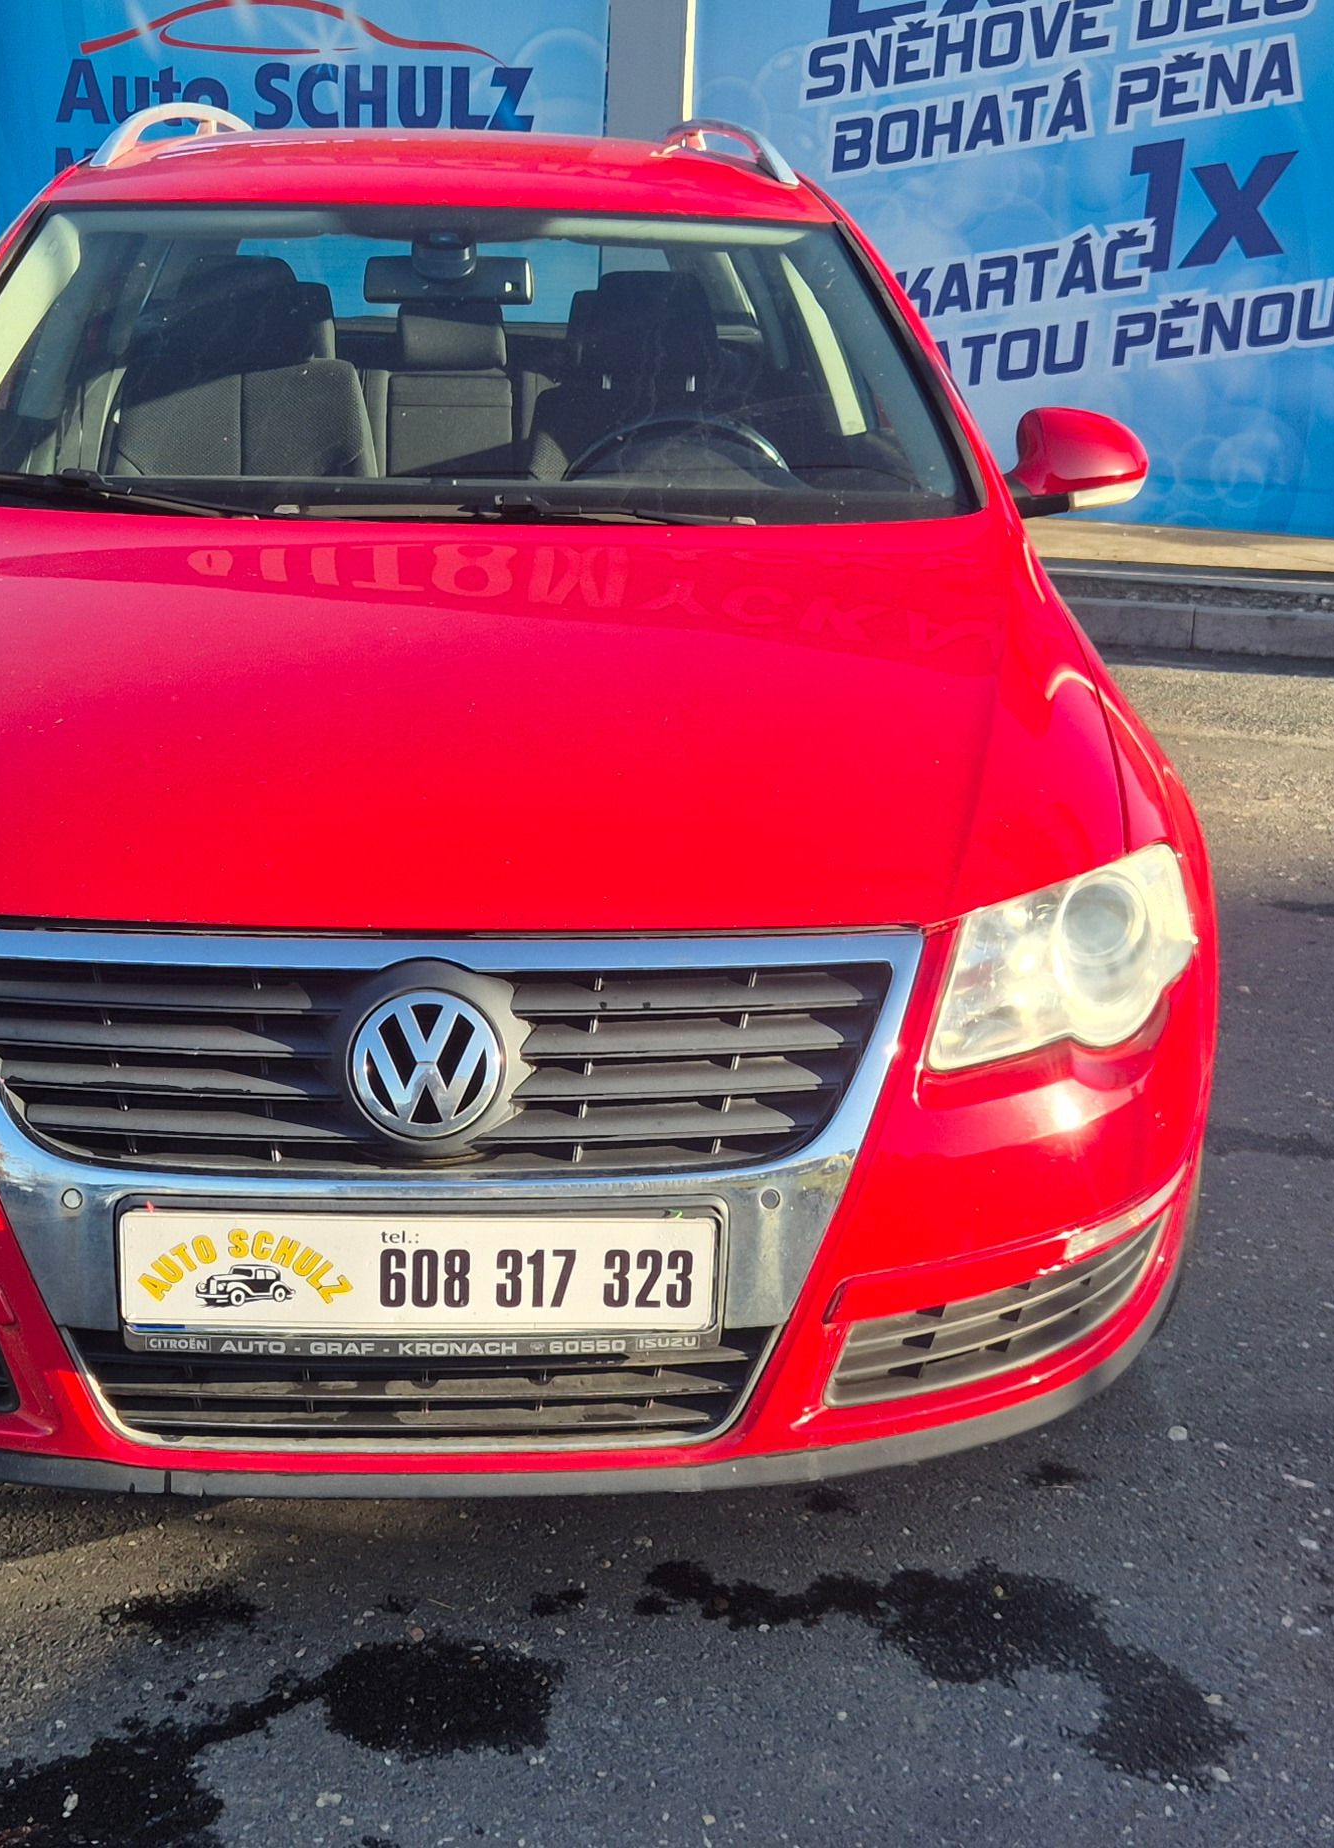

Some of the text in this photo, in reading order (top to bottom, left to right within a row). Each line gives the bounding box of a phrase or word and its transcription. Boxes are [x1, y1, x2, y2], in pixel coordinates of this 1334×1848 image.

[55, 58, 534, 132] Auto SCHULZ
[831, 41, 1294, 173] BOHATÁ PĚNA
[895, 228, 1147, 318] KARTÁČ
[138, 1228, 354, 1305] AUTO SCHULZ
[380, 1230, 419, 1244] tel.:
[380, 1248, 693, 1308] 608 317 323
[149, 1336, 207, 1350] CITROËN
[220, 1340, 286, 1354] AUTO
[310, 1342, 375, 1355] GRAF
[398, 1342, 517, 1356] KRONACH
[549, 1340, 626, 1353] 60550
[639, 1336, 697, 1349] ISUZU
